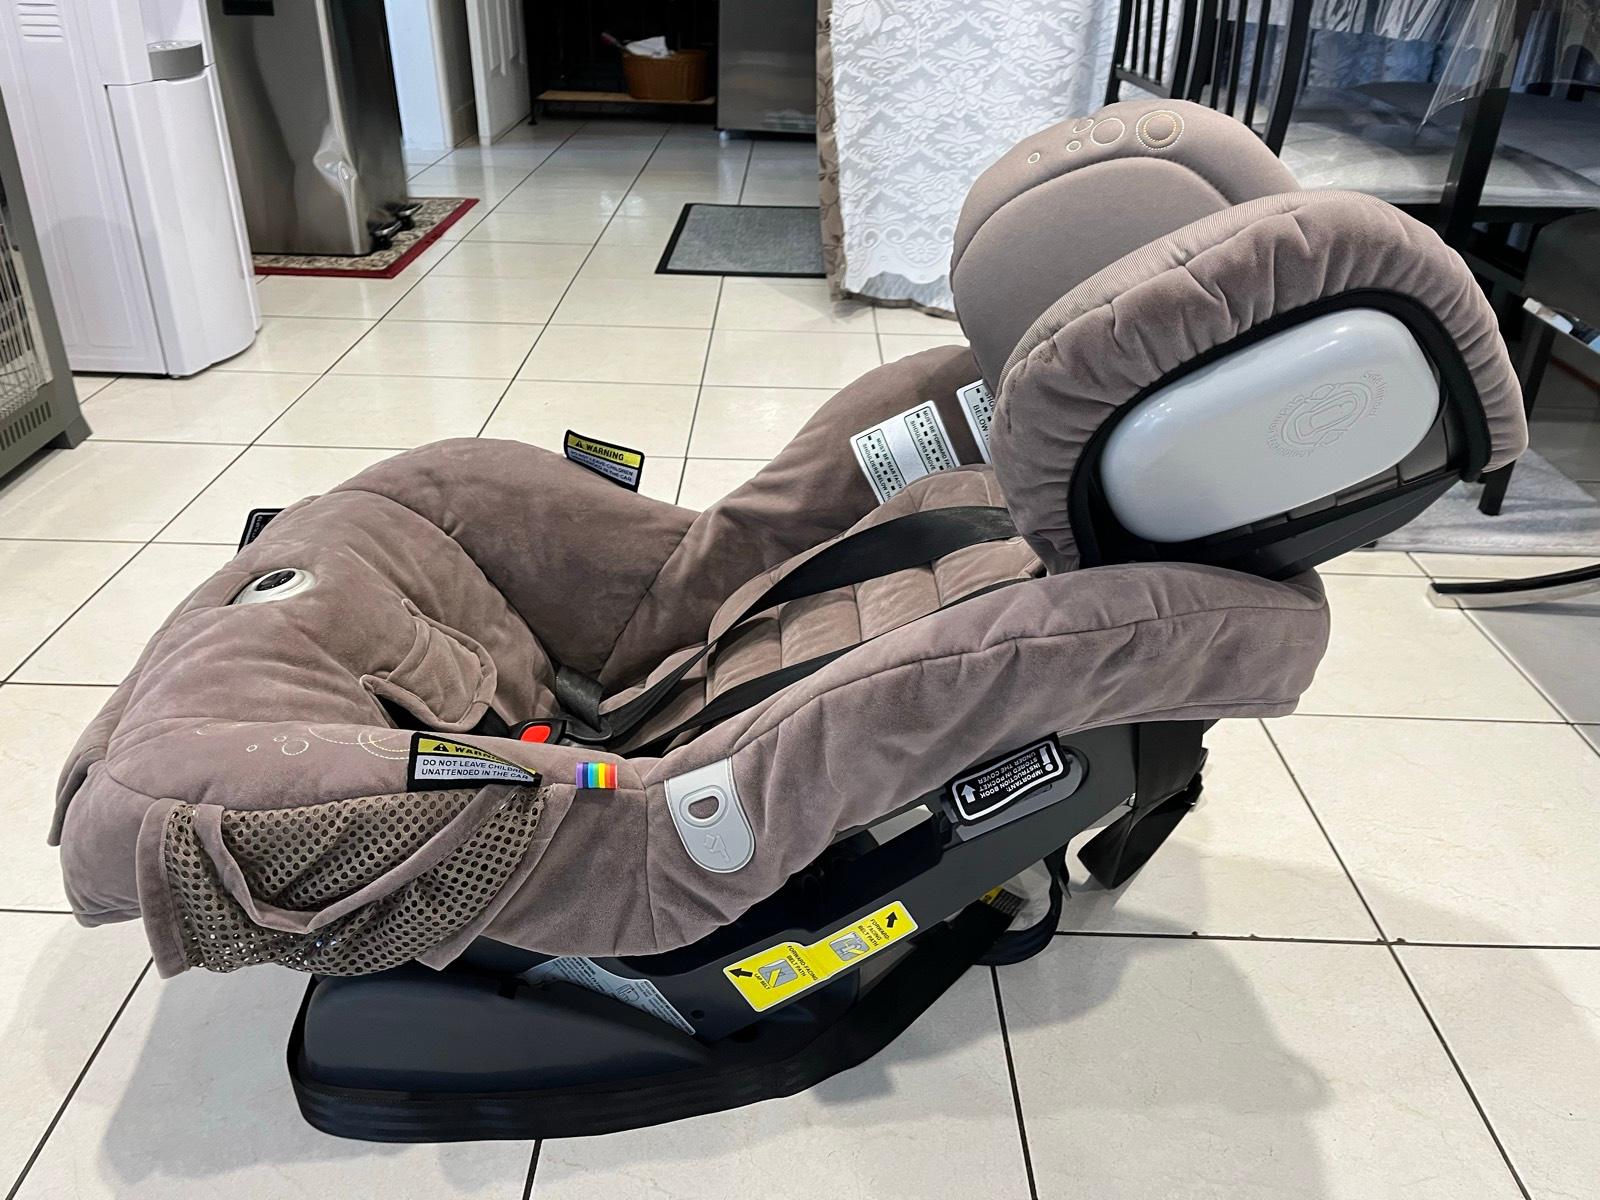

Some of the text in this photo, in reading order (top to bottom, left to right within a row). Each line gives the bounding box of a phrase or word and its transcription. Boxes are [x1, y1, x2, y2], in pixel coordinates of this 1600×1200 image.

[973, 405, 988, 431] BELOW
[910, 421, 936, 470] SHOULDERS ABOVE
[922, 410, 933, 426] MUST
[932, 433, 948, 459] FORWARD
[586, 444, 624, 461] WARNING
[876, 438, 886, 452] MUST
[887, 461, 896, 475] REAR
[893, 474, 903, 489] FACIN
[607, 463, 633, 475] CHILDREN
[862, 444, 880, 474] SHOULDERS
[877, 474, 888, 491] BELOW
[1013, 757, 1038, 774] STORED
[1014, 752, 1036, 766] UNDER
[978, 770, 1000, 784] COVER
[979, 774, 1005, 792] POCKET
[980, 763, 1041, 799] INSTRUCTION BOOK
[1006, 770, 1044, 792] IMPORTANT:
[858, 925, 878, 947] BELT PATH
[787, 955, 806, 977] BELT PATH
[761, 980, 770, 991] BELT
